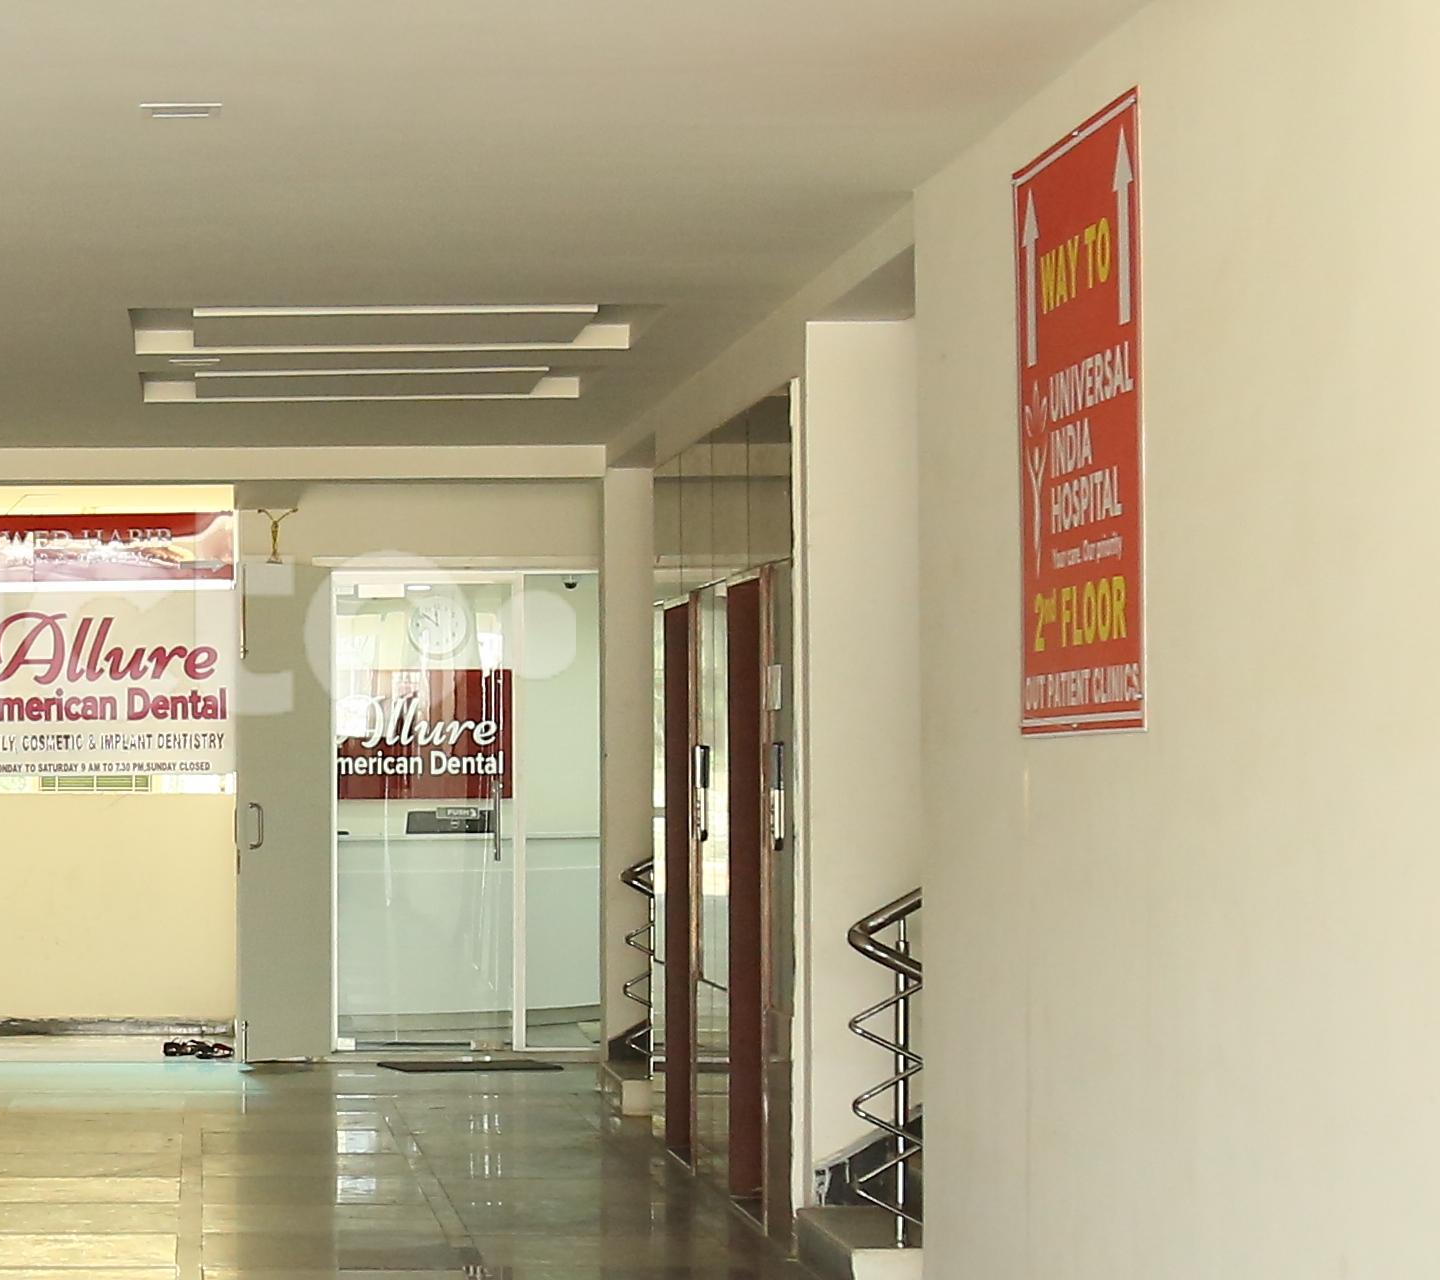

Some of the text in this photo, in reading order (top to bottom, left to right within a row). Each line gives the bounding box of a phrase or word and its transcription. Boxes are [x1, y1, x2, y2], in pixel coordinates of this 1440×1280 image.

[1040, 217, 1111, 315] WAY TO
[1049, 340, 1134, 421] UNIVERSAL
[1051, 417, 1093, 479] INDIA
[1051, 463, 1123, 534] HOSPITAL
[1061, 576, 1127, 648] FLOOR
[126, 687, 228, 721] Dental
[1026, 663, 1141, 711] OUT PATIENT CLINICS
[22, 734, 83, 752] COSMETIC
[88, 734, 97, 750] &
[101, 733, 153, 750] IMPLANT
[157, 732, 224, 750] DENTISTRY
[25, 763, 36, 773] TO
[38, 762, 79, 773] SATURDAY
[88, 762, 100, 772] AM
[102, 762, 114, 772] TO
[179, 761, 211, 771] CLOSED
[337, 750, 504, 775] merican Dental
